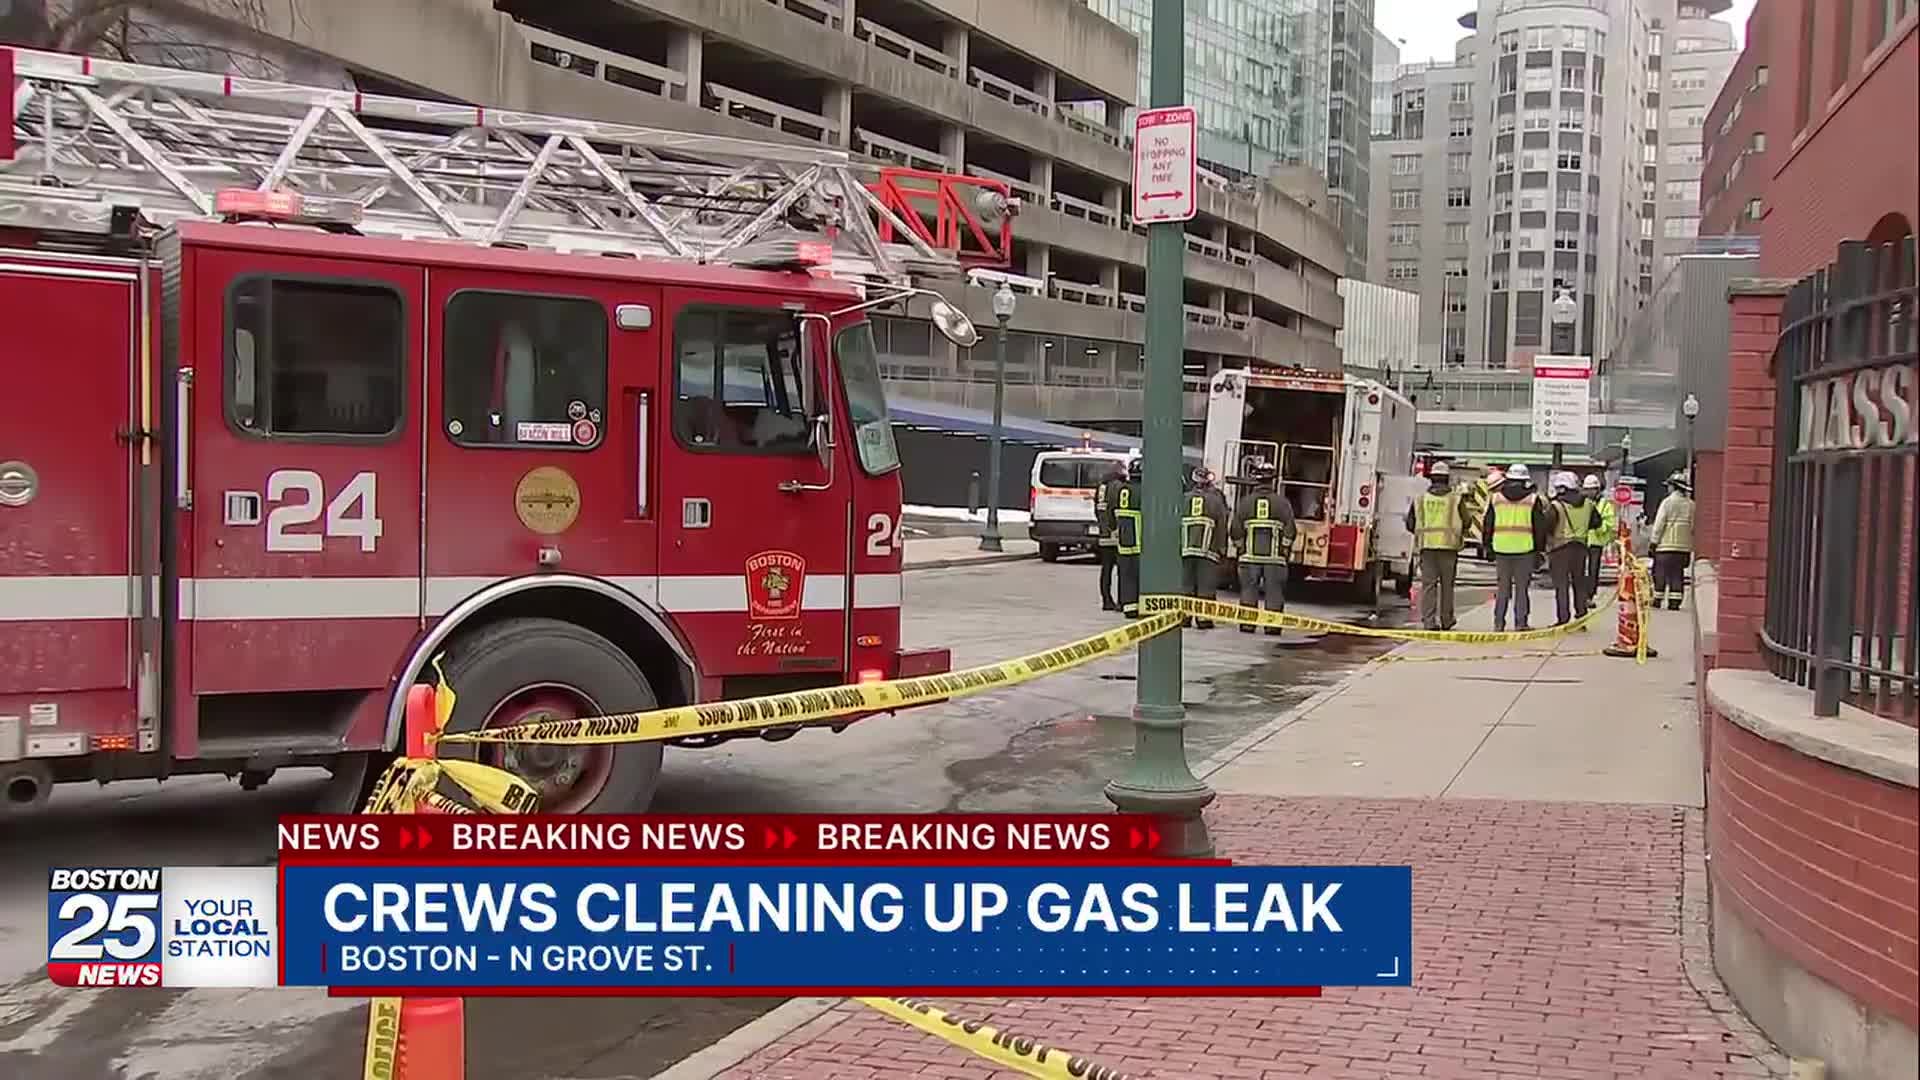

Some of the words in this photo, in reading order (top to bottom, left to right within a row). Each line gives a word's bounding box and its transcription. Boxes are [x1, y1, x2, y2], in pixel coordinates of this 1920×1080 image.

[1165, 111, 1191, 122] ZONE
[1155, 136, 1169, 146] NO
[1152, 161, 1173, 171] ANY
[266, 469, 383, 552] 24
[749, 554, 803, 572] BOSTON
[1144, 598, 1179, 611] CROSS
[790, 622, 803, 637] in
[737, 641, 757, 656] the
[698, 706, 734, 727] CROSS
[738, 704, 758, 722] NOT
[760, 702, 775, 719] DO
[584, 713, 640, 738] BOSTON
